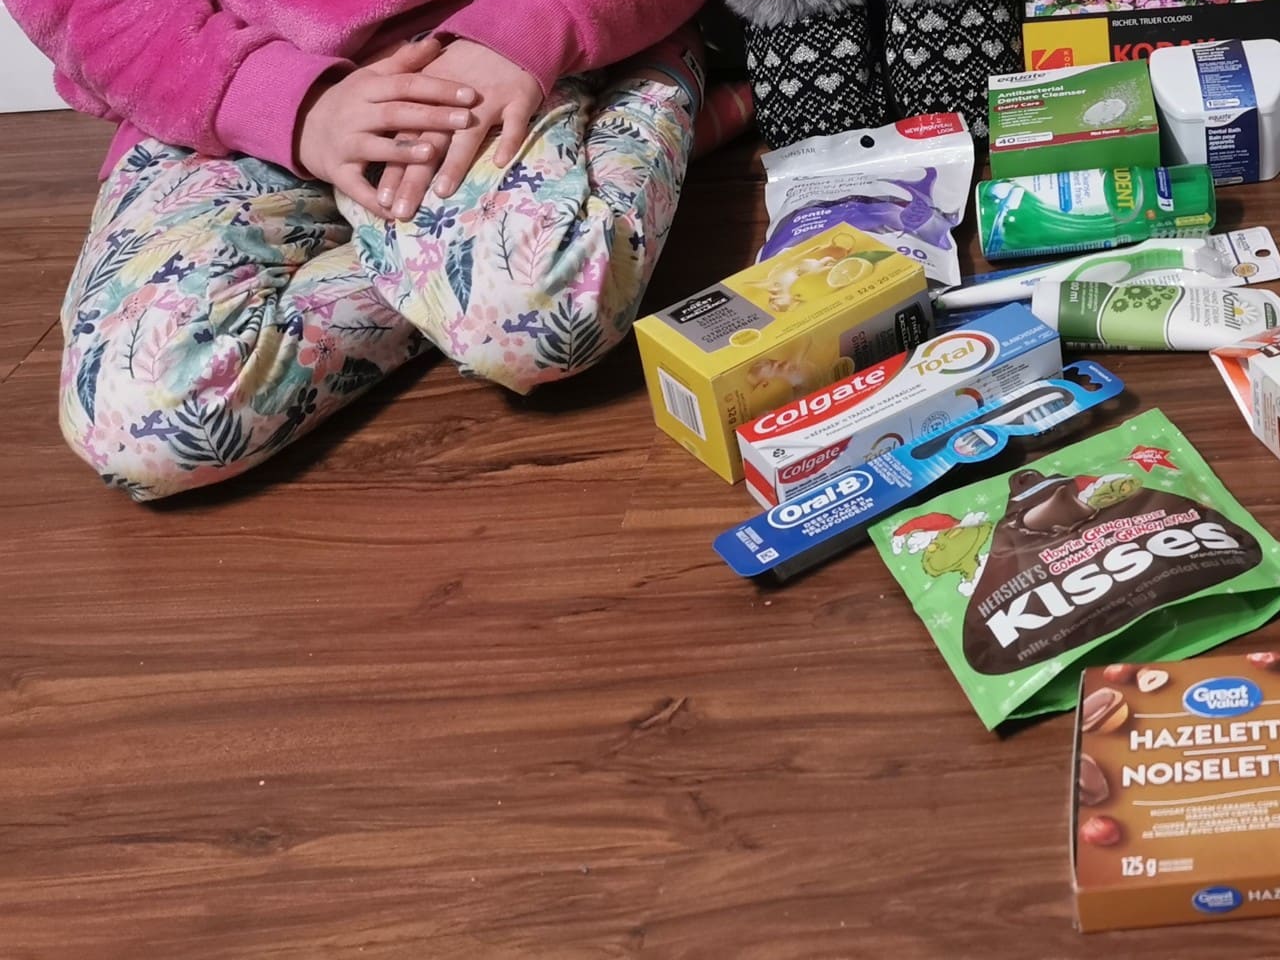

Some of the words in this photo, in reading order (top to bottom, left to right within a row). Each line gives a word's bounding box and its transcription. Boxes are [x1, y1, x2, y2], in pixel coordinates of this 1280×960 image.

[996, 71, 1047, 84] equate
[997, 85, 1064, 99] Antibacterial
[997, 93, 1040, 105] Denture
[1041, 89, 1088, 98] Cleanser
[999, 138, 1016, 146] 40
[1113, 167, 1136, 210] LIDENT
[896, 246, 928, 260] 90
[1222, 289, 1242, 330] Kamill
[909, 340, 976, 378] Total
[753, 366, 886, 436] Colgate
[781, 446, 840, 480] Colgate
[779, 476, 861, 522] Oral-B
[803, 509, 829, 528] DEEP
[831, 496, 864, 516] CLEAN
[802, 504, 859, 535] NETTOYAGE
[808, 502, 874, 538] PROFONDEUR
[1082, 518, 1132, 543] GRINCH
[1049, 538, 1107, 575] COMMENT
[1114, 520, 1164, 544] GRINCH
[977, 564, 1048, 618] HERSHEY'S
[1017, 637, 1050, 662] milk
[1136, 564, 1200, 593] chocolat
[1201, 558, 1220, 570] au
[1193, 684, 1249, 704] Great
[1207, 698, 1249, 710] Value
[1121, 856, 1144, 876] 125
[1146, 858, 1157, 877] g
